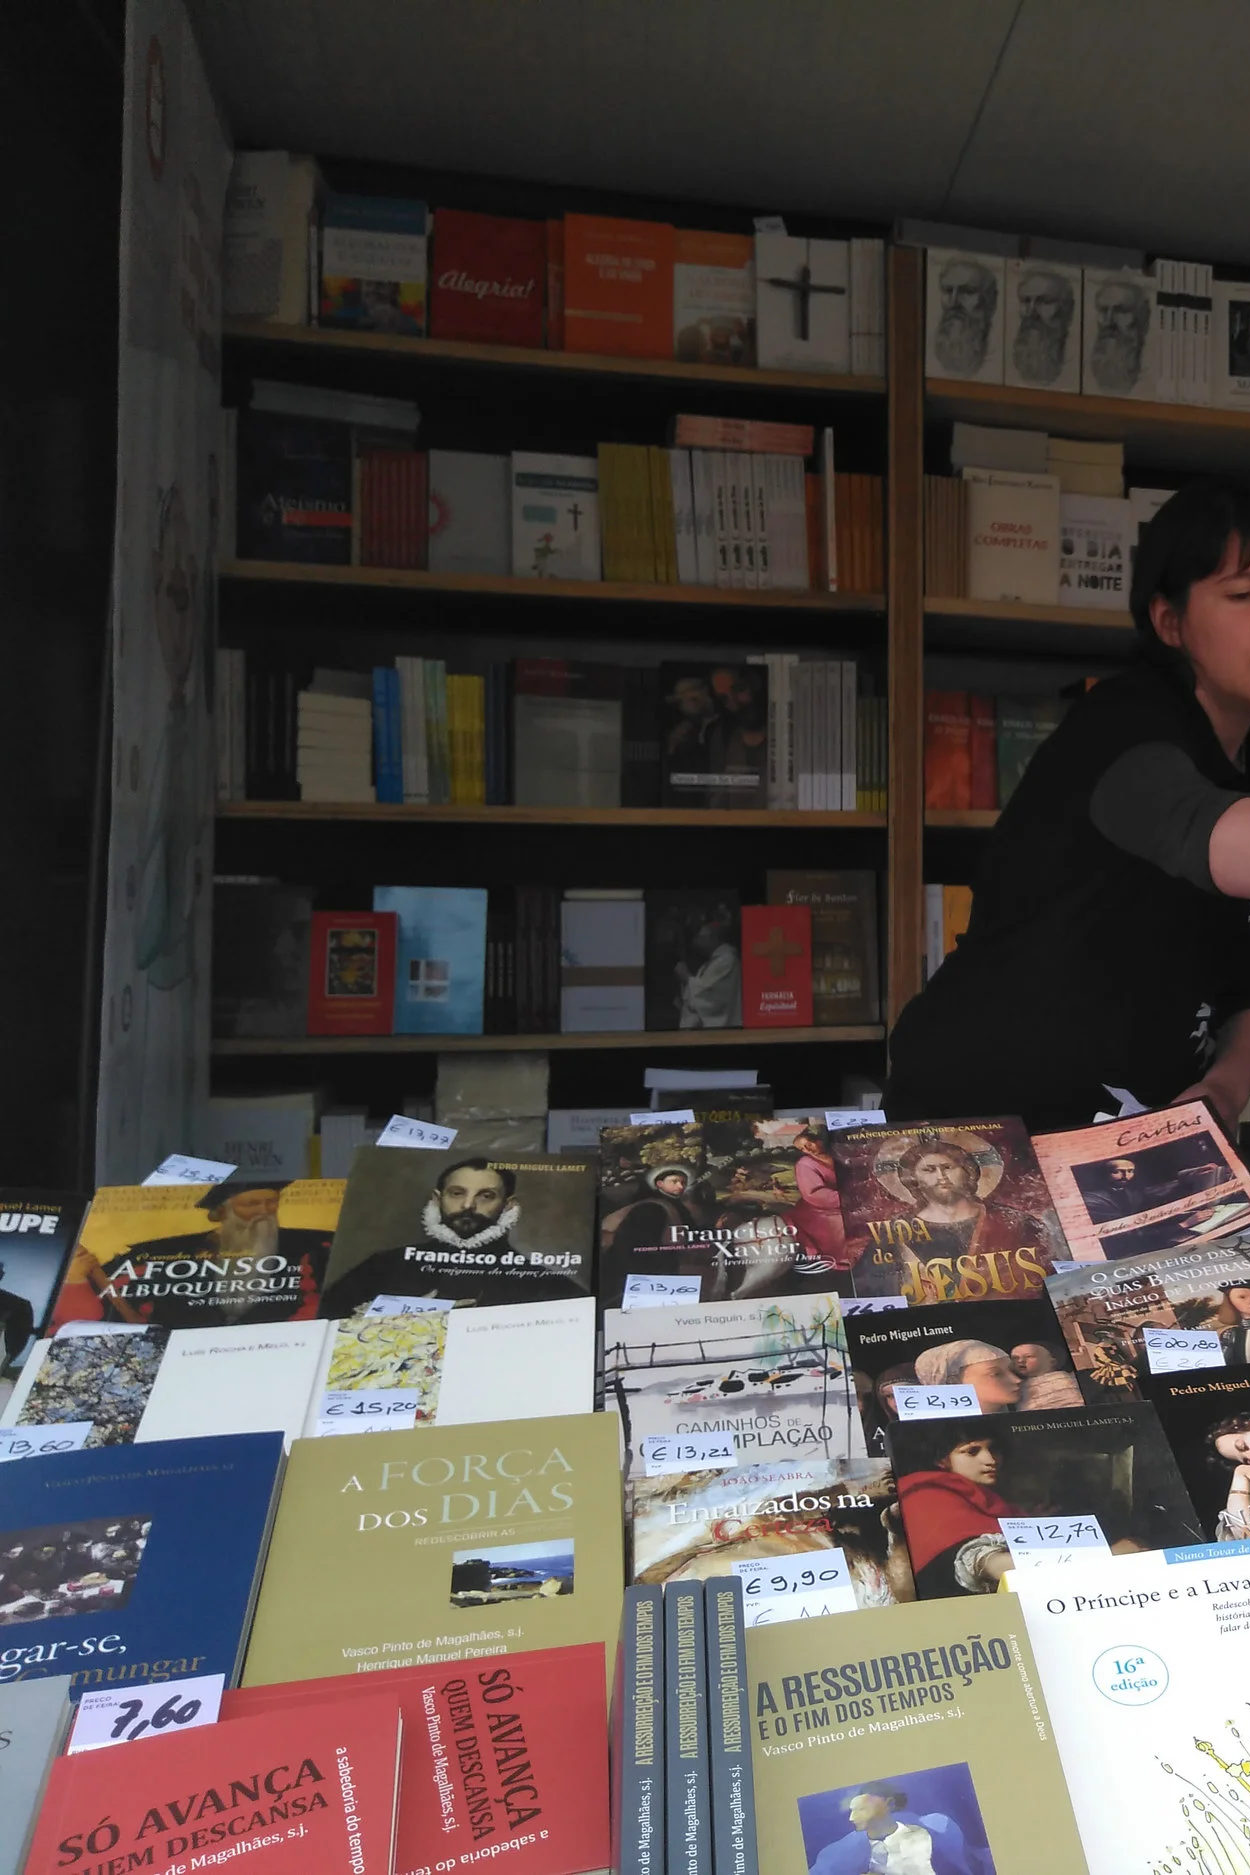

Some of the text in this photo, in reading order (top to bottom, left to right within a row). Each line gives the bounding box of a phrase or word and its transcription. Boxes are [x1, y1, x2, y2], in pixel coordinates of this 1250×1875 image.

[437, 270, 534, 298] Alegria!
[990, 522, 1033, 535] OBRAS
[974, 535, 1048, 550] COMPLETAS
[1060, 558, 1122, 573] ENTREGAR
[1059, 575, 1122, 591] A NOITE
[1117, 1114, 1202, 1148] Cartas
[556, 1164, 586, 1172] LAMET
[669, 1224, 798, 1242] Francisco
[866, 1218, 933, 1245] VIDA
[404, 1247, 582, 1268] Francisco de Borja
[713, 1242, 800, 1259] Xavier
[873, 1248, 894, 1264] de
[110, 1256, 288, 1280] AFONSO
[903, 1247, 1046, 1303] JESUS
[1091, 1248, 1236, 1284] O CAVALEIRO DAS
[98, 1276, 301, 1299] ALBUQUERQUE
[860, 1325, 953, 1344] Pedro Miguel Lamet
[1170, 1386, 1206, 1396] Pedro
[1209, 1379, 1250, 1392] Miguel
[652, 1446, 732, 1460] € 13,21
[340, 1448, 574, 1492] A FORÇA
[358, 1483, 574, 1531] DOS DIAS
[667, 1493, 874, 1526] Enraizados na
[711, 1515, 833, 1542] Certeza
[1036, 1524, 1096, 1543] 12,79
[746, 1570, 839, 1594] € 9,90
[1047, 1598, 1065, 1615] O
[1075, 1592, 1162, 1613] Príncipe
[1168, 1588, 1179, 1599] e
[1187, 1586, 1198, 1597] a
[1220, 1625, 1240, 1635] falar
[357, 1644, 507, 1672] Henrique Manuel Pereira
[756, 1633, 1012, 1716] A RESSURREIÇÃO
[1110, 1677, 1158, 1692] edição
[110, 1695, 202, 1741] 7,60
[759, 1683, 954, 1740] E O FIM DOS TEMPOS
[762, 1742, 805, 1758] Vasco
[807, 1731, 845, 1746] Pinto
[848, 1726, 865, 1737] de
[868, 1711, 944, 1734] Magalhães,
[441, 1679, 496, 1842] QUEM DESCANSA
[478, 1668, 543, 1830] SÓ AVANÇA
[56, 1758, 327, 1867] SÓ AVANÇA
